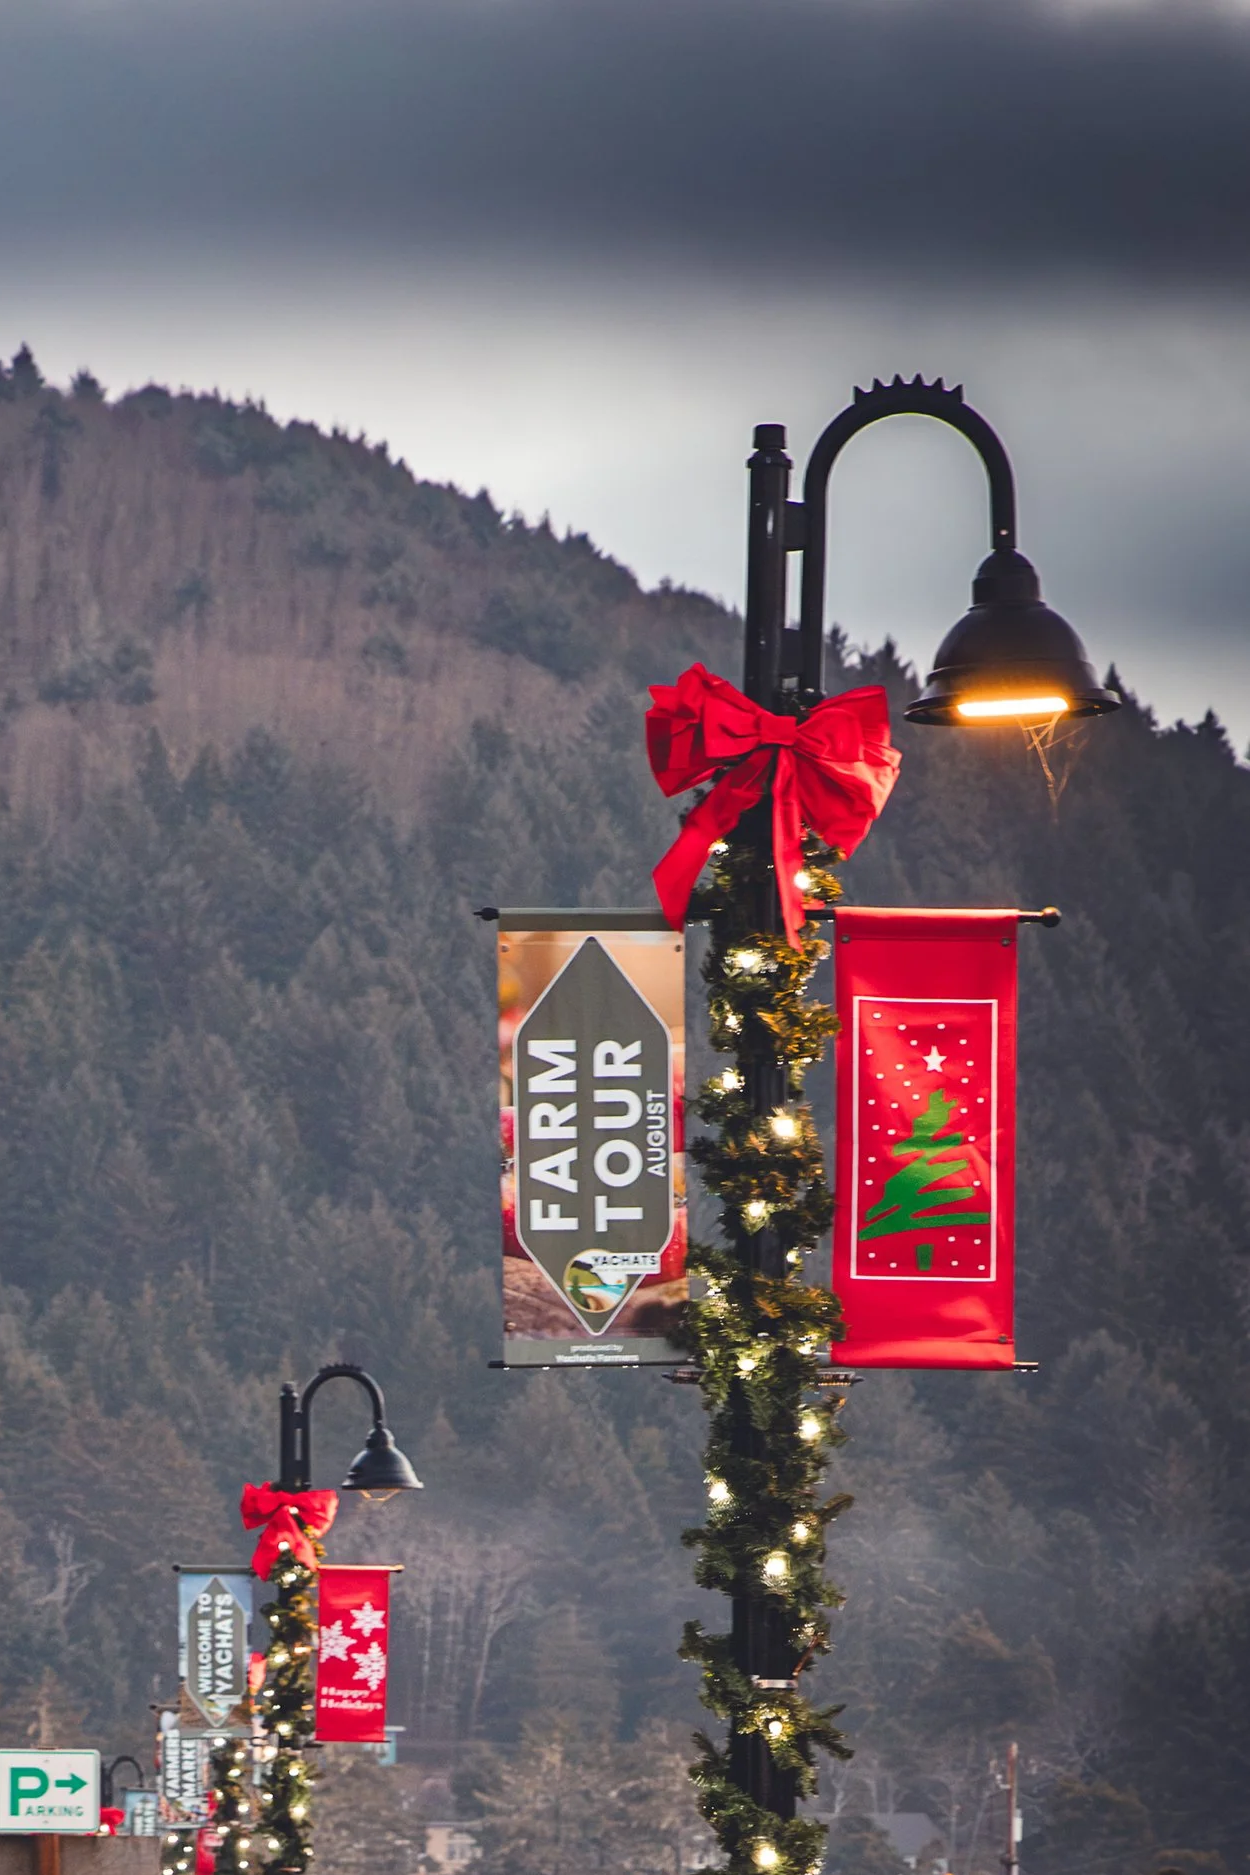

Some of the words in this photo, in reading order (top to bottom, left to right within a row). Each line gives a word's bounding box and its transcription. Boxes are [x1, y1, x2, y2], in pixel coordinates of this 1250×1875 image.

[527, 1038, 579, 1232] FARM
[592, 1038, 644, 1233] TOUR
[645, 1089, 667, 1178] AUGUST
[592, 1255, 659, 1266] YACHATS
[197, 1592, 212, 1614] TO
[197, 1619, 212, 1694] WELCOME
[214, 1593, 234, 1694] YACHATS
[320, 1698, 383, 1712] Holidays
[321, 1686, 370, 1698] Happy
[10, 1767, 84, 1817] PARKING
[164, 1729, 181, 1798] FARMERS
[180, 1739, 196, 1797] MARKE
